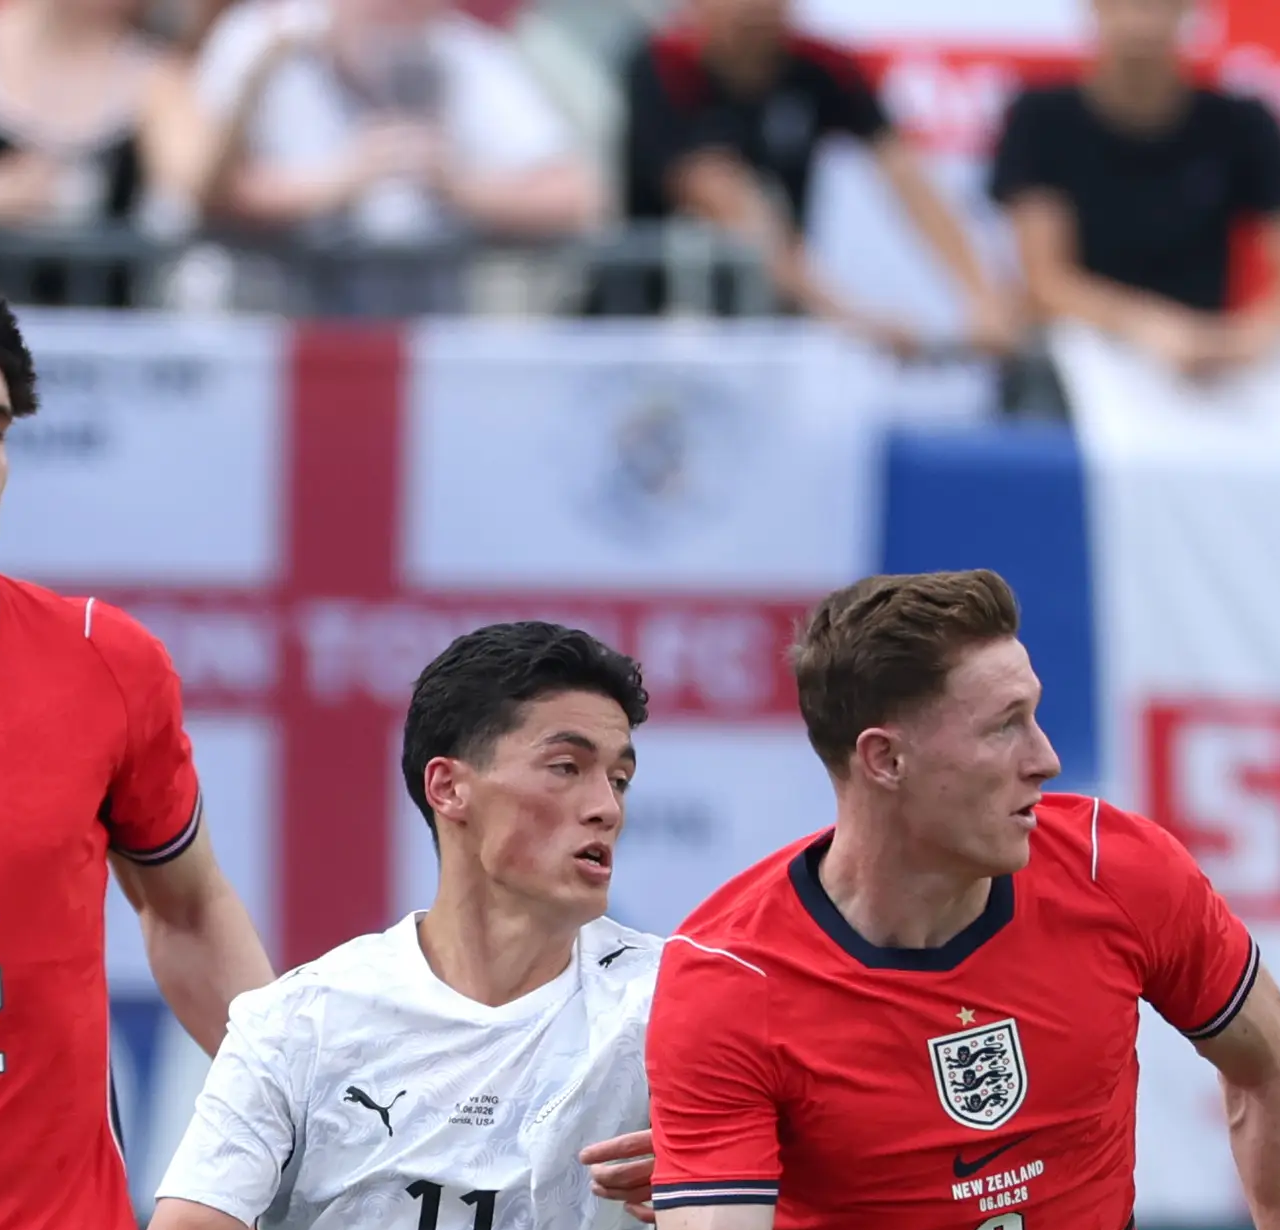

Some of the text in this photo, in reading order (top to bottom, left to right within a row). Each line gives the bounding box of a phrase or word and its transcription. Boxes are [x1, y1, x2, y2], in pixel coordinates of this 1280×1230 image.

[952, 1160, 1044, 1200] NEW ZEALAND
[979, 1185, 1029, 1212] 06.06.26
